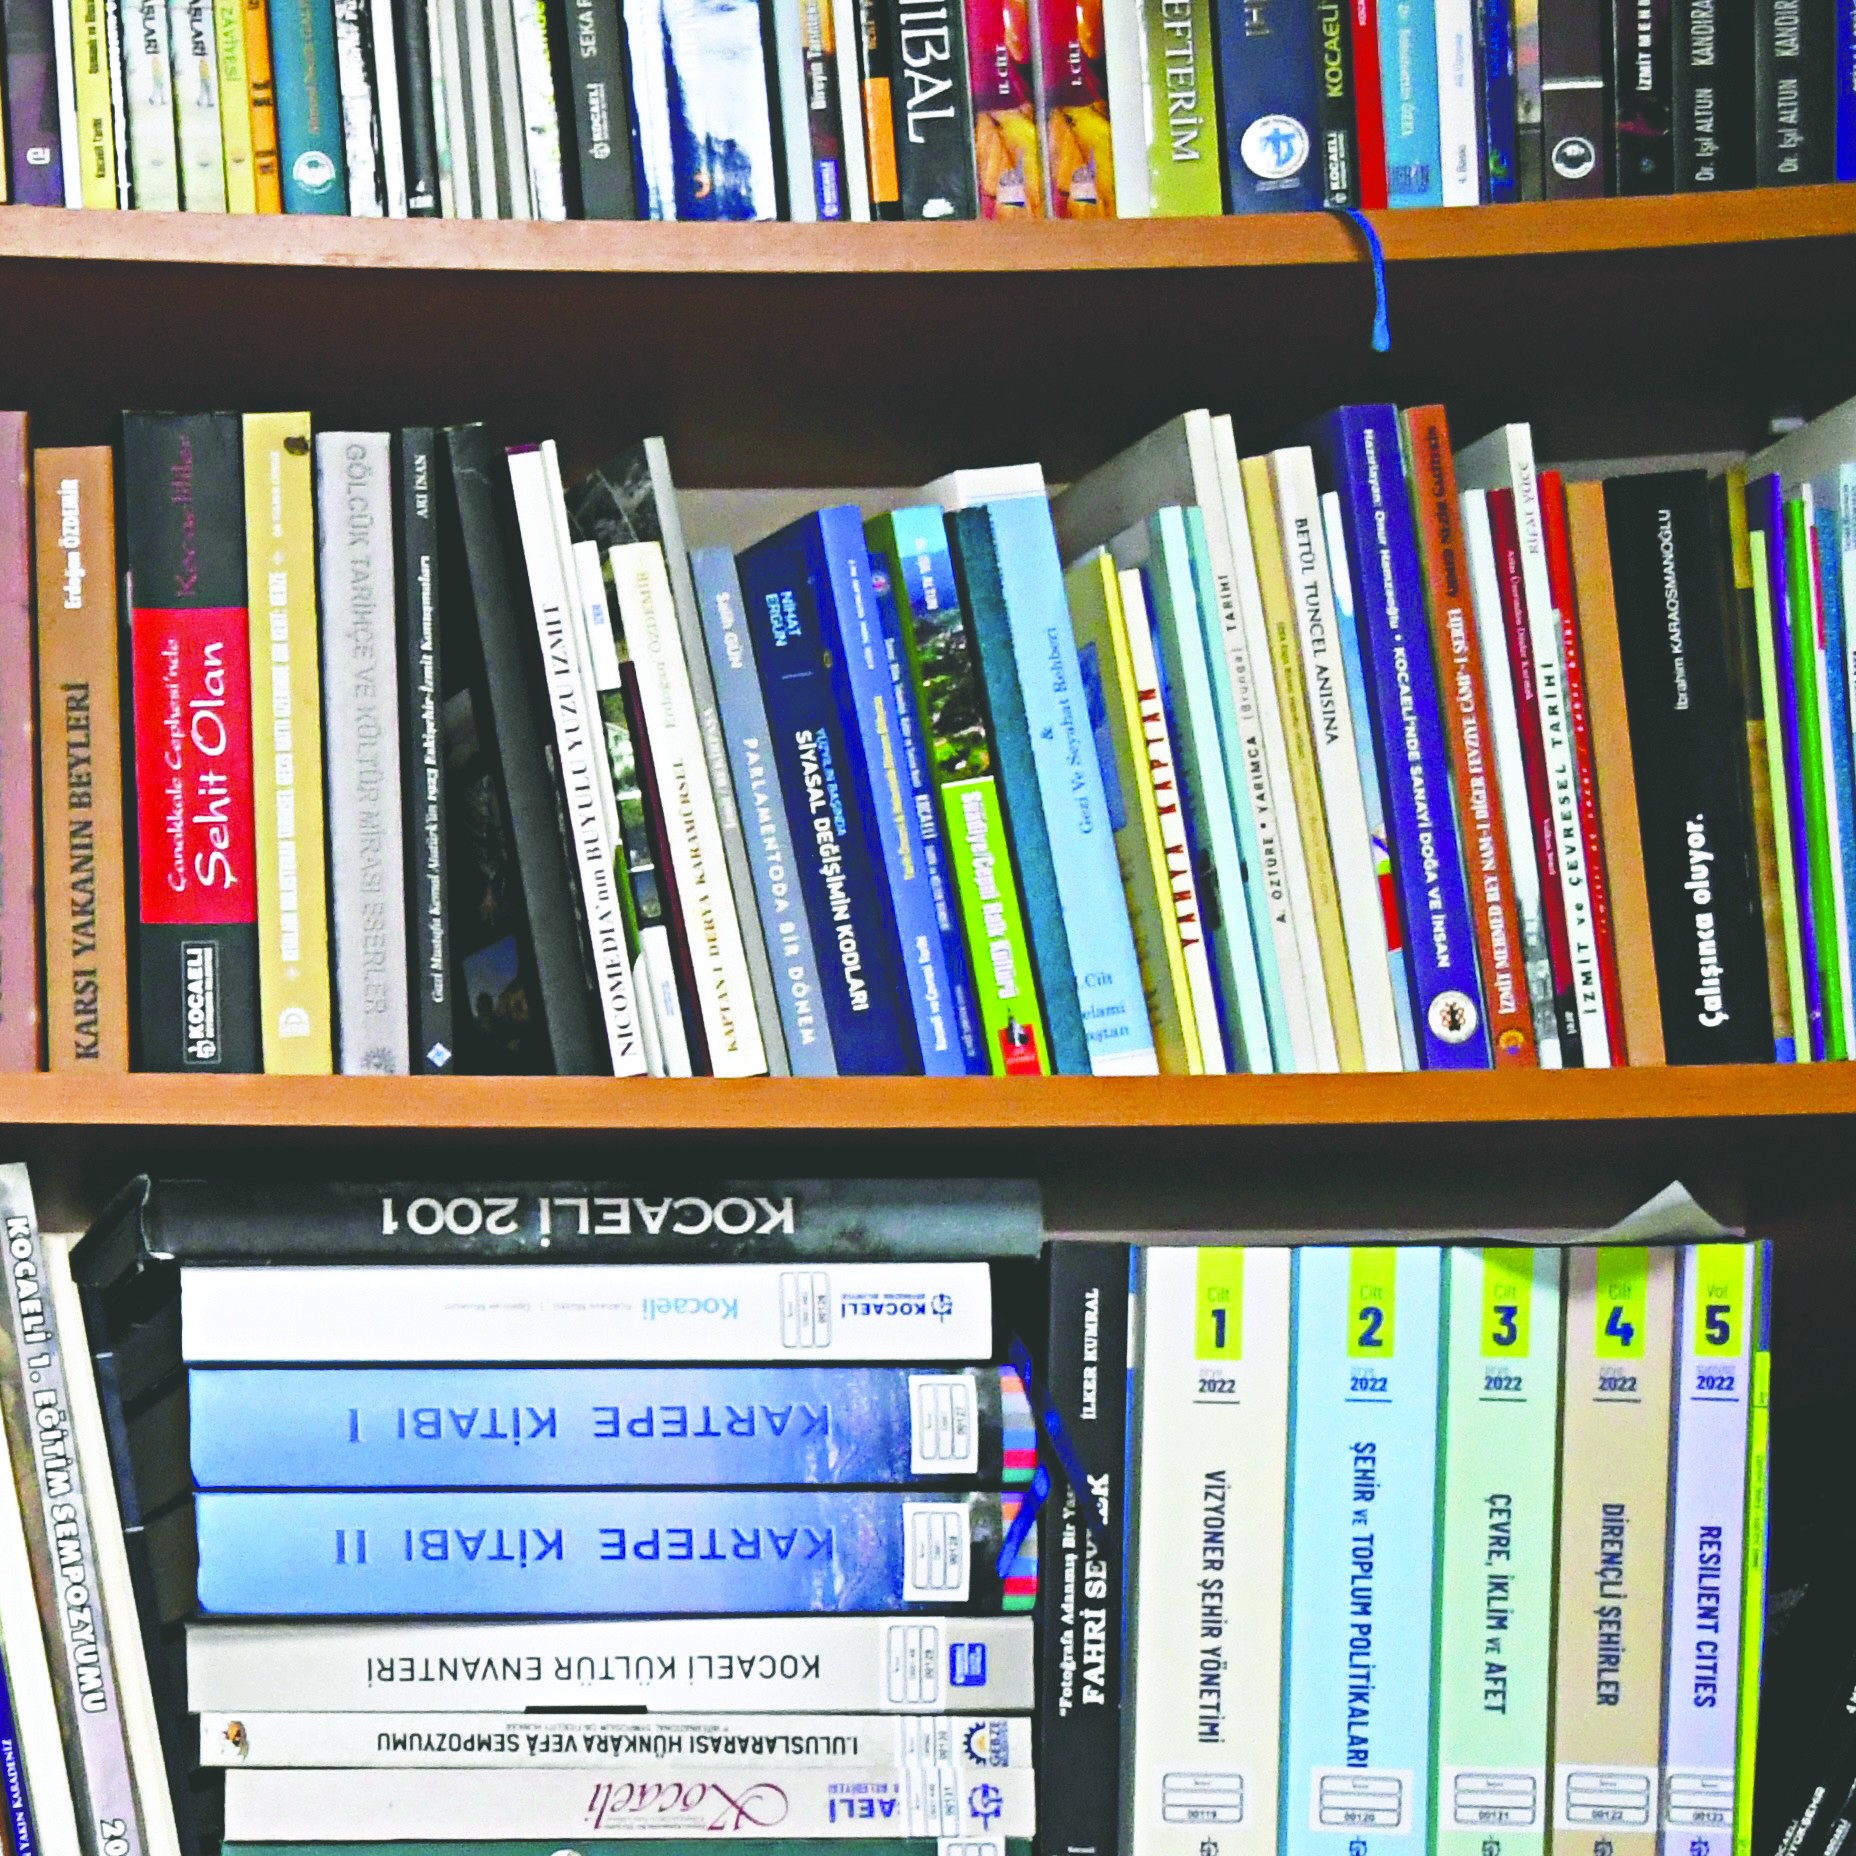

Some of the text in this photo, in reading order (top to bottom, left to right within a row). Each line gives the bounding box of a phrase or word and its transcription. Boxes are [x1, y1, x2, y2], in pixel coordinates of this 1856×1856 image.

[578, 10, 597, 57] SEKA
[1293, 516, 1339, 745] BETÜL TUNCEL ANISINA
[1655, 508, 1689, 710] İbrahim KARAOSMANOĞLU
[1538, 661, 1565, 748] TARİHİ
[188, 641, 236, 889] Şehit Olan
[1136, 687, 1199, 948] YAHYA KAPTAN
[1551, 763, 1583, 886] ÇEVRESEL
[63, 682, 99, 1059] KARŞI YAKANIN BEYLERİ
[742, 736, 819, 1045] PARLAMENTODA BİR DÖNEM
[792, 728, 872, 1012] SİYASAL DEĞİŞİMİN KODLARI
[1568, 902, 1588, 926] ve
[1678, 813, 1729, 1027] Çalışınca oluyor.
[186, 948, 204, 1038] KOCAELİ
[1573, 939, 1599, 1015] İZMİT
[380, 1194, 794, 1246] KOCAELİ 2001
[642, 1297, 737, 1320] Kocaeli
[840, 1302, 925, 1317] KOCAELİ
[1211, 1308, 1226, 1348] 1
[1357, 1306, 1384, 1347] 2
[1493, 1305, 1517, 1346] 3
[1605, 1306, 1634, 1346] 4
[1705, 1305, 1731, 1345] 5
[1080, 1287, 1099, 1418] İLKER KUMRAL
[1198, 1378, 1236, 1394] 2022
[1350, 1376, 1388, 1392] 2022
[1484, 1376, 1522, 1391] 2022
[1599, 1376, 1637, 1391] 2022
[1696, 1375, 1734, 1391] 2022
[348, 1404, 827, 1445] KARTEPE KİTABI I
[4, 1214, 108, 1715] KOCAELİ 1. EĞİTİM SEMPOZYUMU
[1348, 1441, 1380, 1501] ŞEHİR
[335, 1526, 832, 1567] KARTEPE KİTABI II
[1481, 1493, 1512, 1566] ÇEVRE,
[1350, 1533, 1374, 1615] TOPLUM
[1485, 1573, 1514, 1630] İKLİM
[1195, 1470, 1231, 1743] VİZYONER ŞEHİR YÖNETİMİ
[1591, 1503, 1629, 1706] DİRENÇLİ ŞEHİRLER
[1692, 1526, 1723, 1707] RESILIENT CITIES
[367, 1654, 818, 1687] KOCAELİ KÜLTÜR ENVANTERİ
[1078, 1608, 1107, 1704] FAHRİ
[1346, 1623, 1376, 1767] POLİTİKALARI
[1482, 1662, 1507, 1714] AFET
[582, 1776, 788, 1836] Kocaeli
